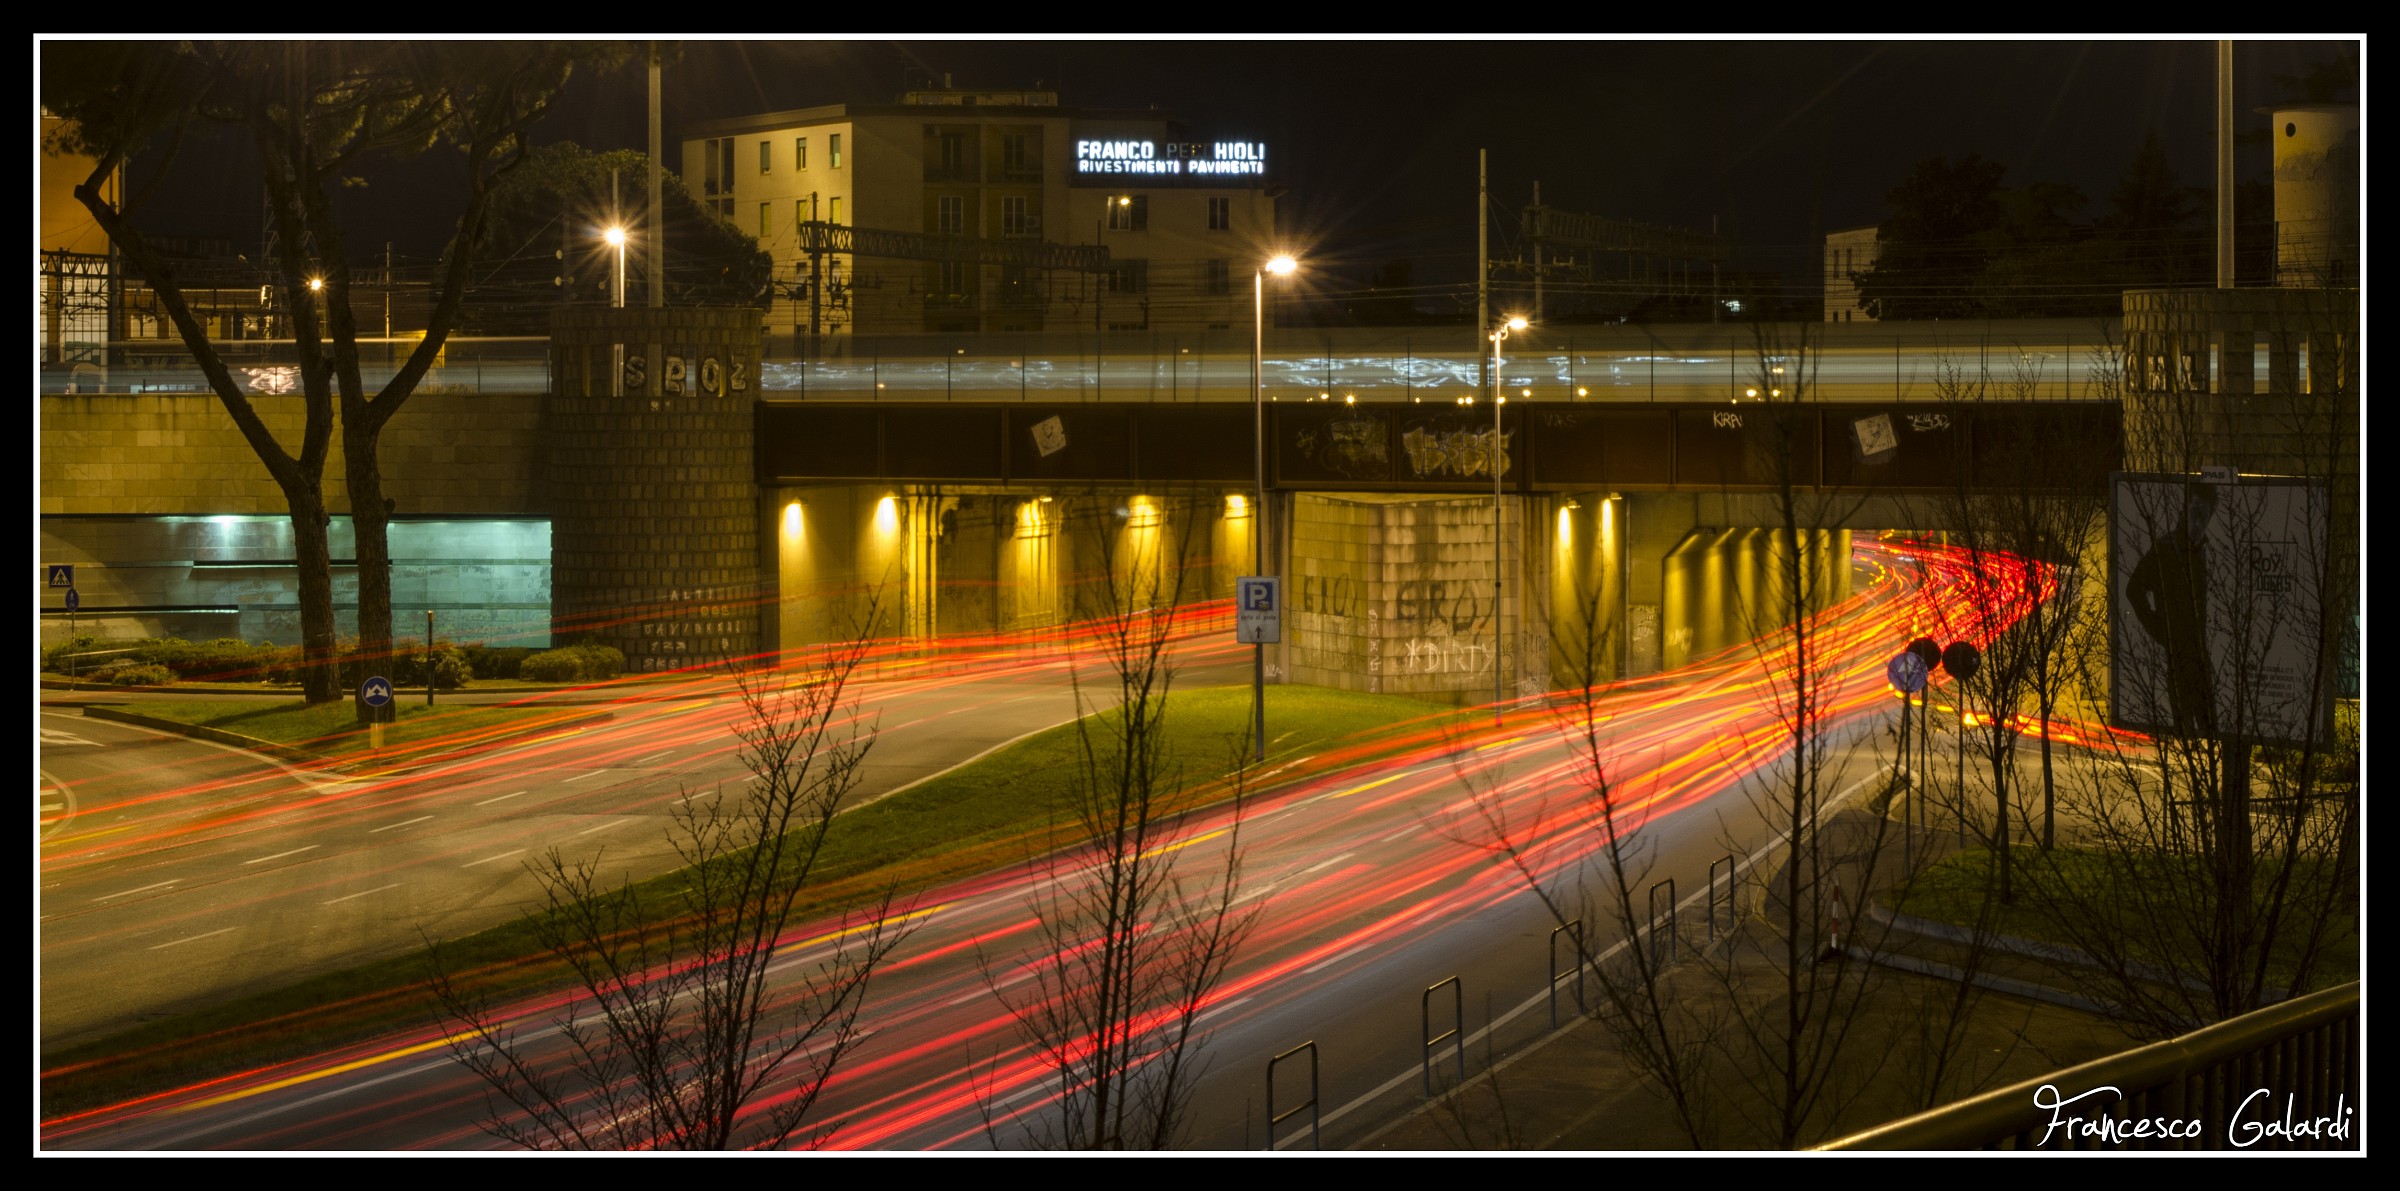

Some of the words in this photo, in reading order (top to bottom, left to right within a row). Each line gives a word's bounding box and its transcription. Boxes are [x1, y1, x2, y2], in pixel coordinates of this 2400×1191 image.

[1078, 141, 1154, 159] FRANCO
[1079, 160, 1179, 173] RIVESTIMENTI
[1188, 160, 1263, 173] PAVIMENTI
[1250, 584, 1268, 608] P
[1424, 635, 1497, 676] DIRTY
